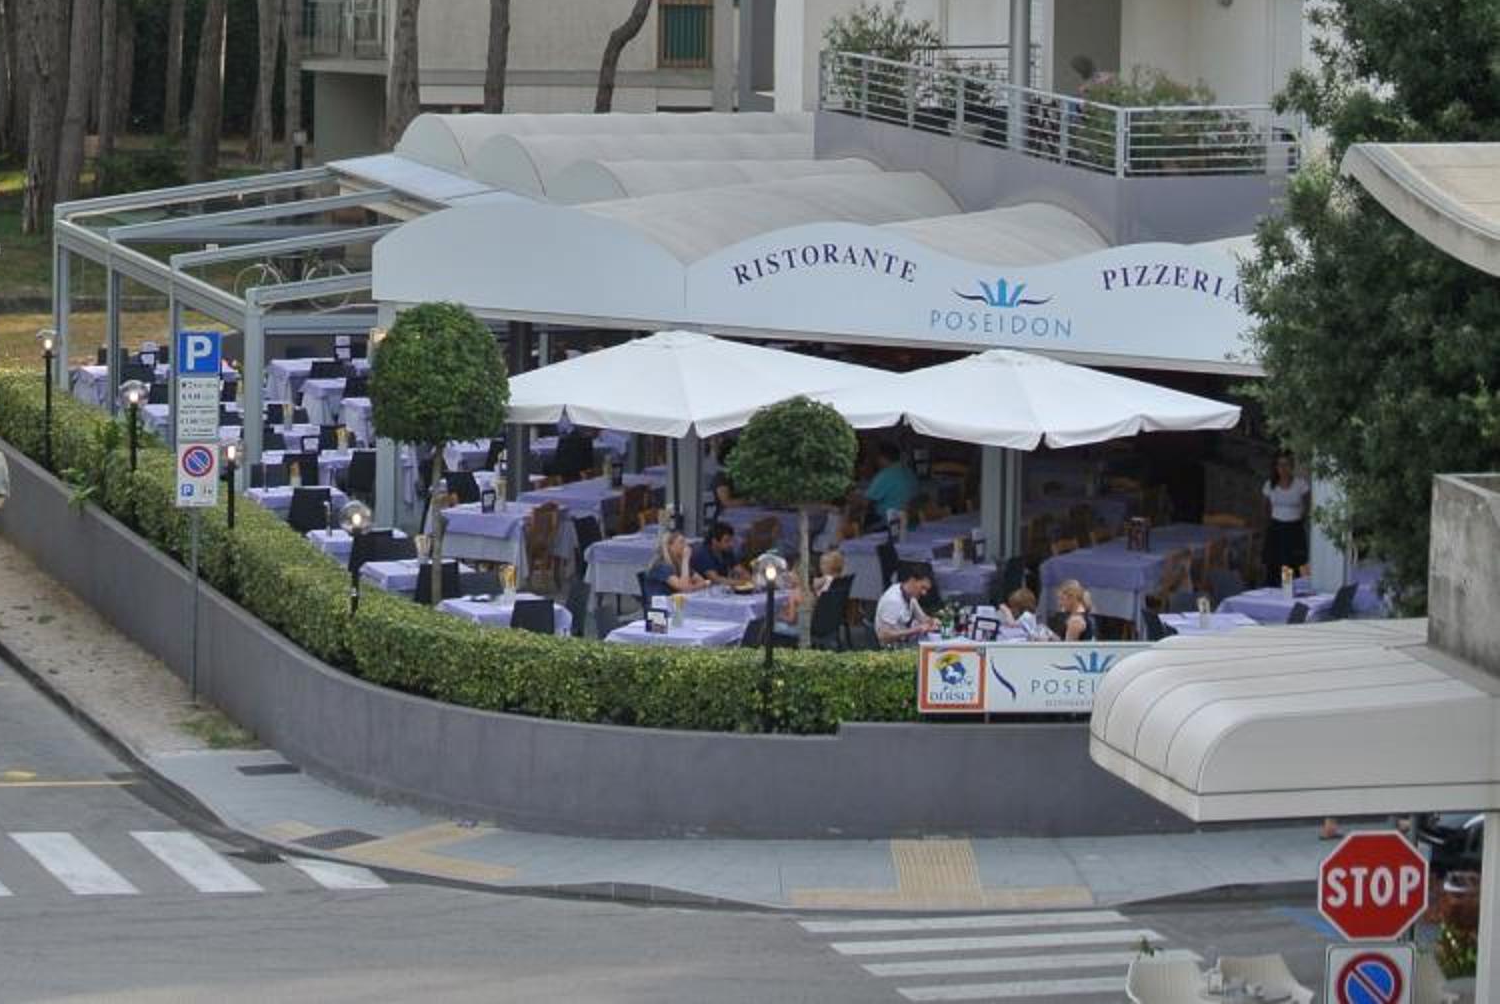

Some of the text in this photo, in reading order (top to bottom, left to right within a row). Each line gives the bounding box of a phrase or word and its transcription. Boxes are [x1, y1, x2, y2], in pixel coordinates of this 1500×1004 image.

[733, 242, 917, 286] RISTORANTE
[1102, 263, 1240, 305] PIZZERIA
[930, 310, 1073, 339] POSEIDON
[185, 335, 213, 371] P
[1030, 678, 1095, 695] POSEI
[1327, 864, 1421, 908] STOP
